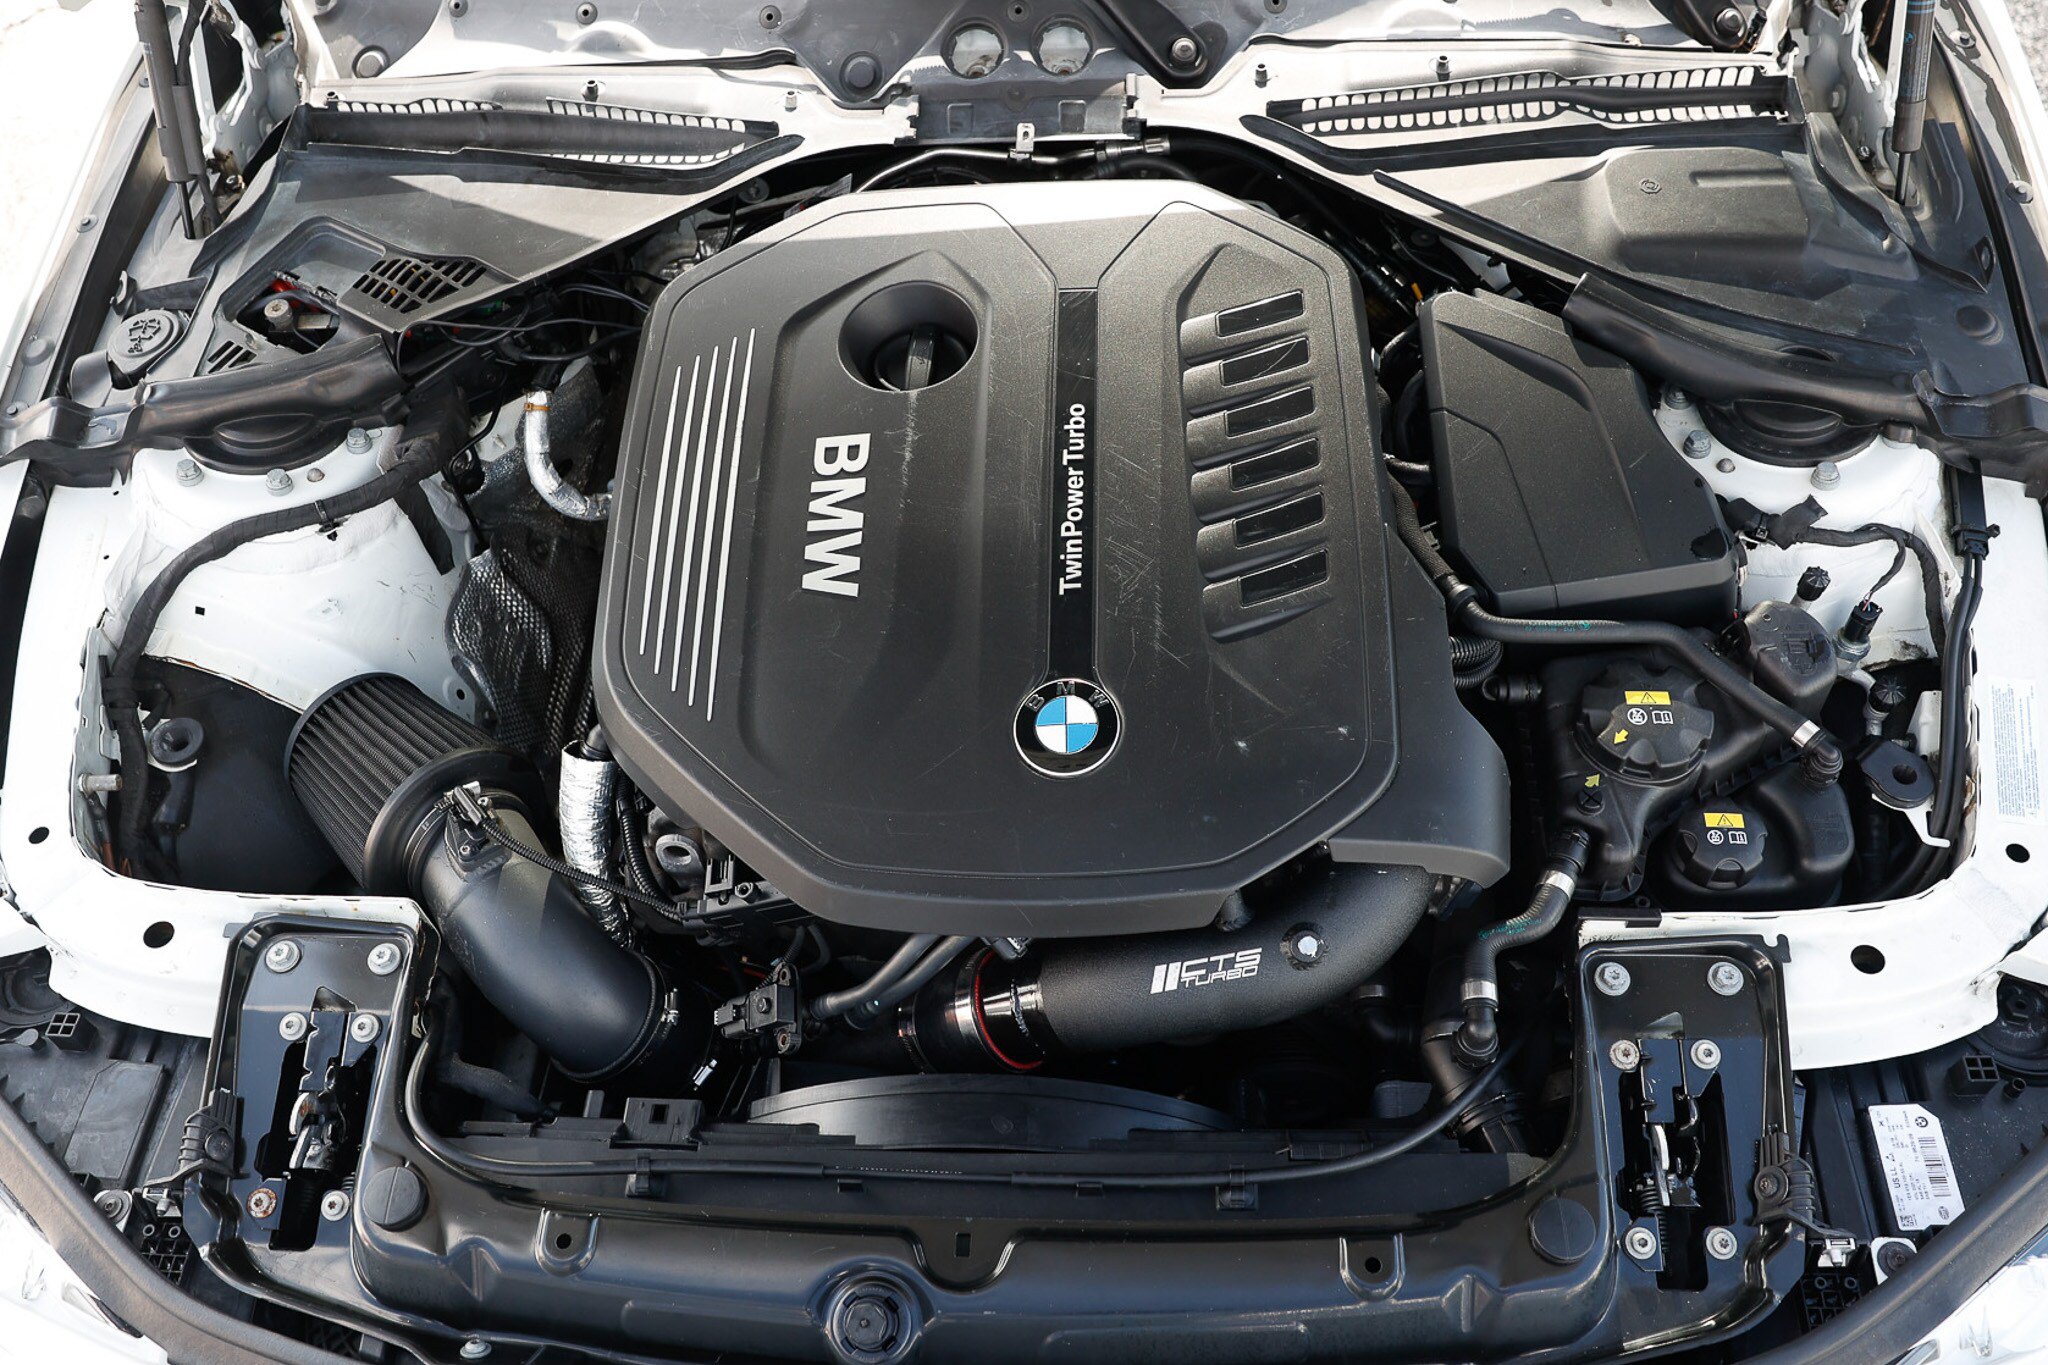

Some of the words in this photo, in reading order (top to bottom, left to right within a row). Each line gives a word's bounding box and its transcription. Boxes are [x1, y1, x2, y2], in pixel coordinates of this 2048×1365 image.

[802, 433, 871, 597] BMW
[1025, 680, 1109, 712] BMW
[1180, 965, 1259, 988] TURBO
[1181, 947, 1262, 978] CTS
